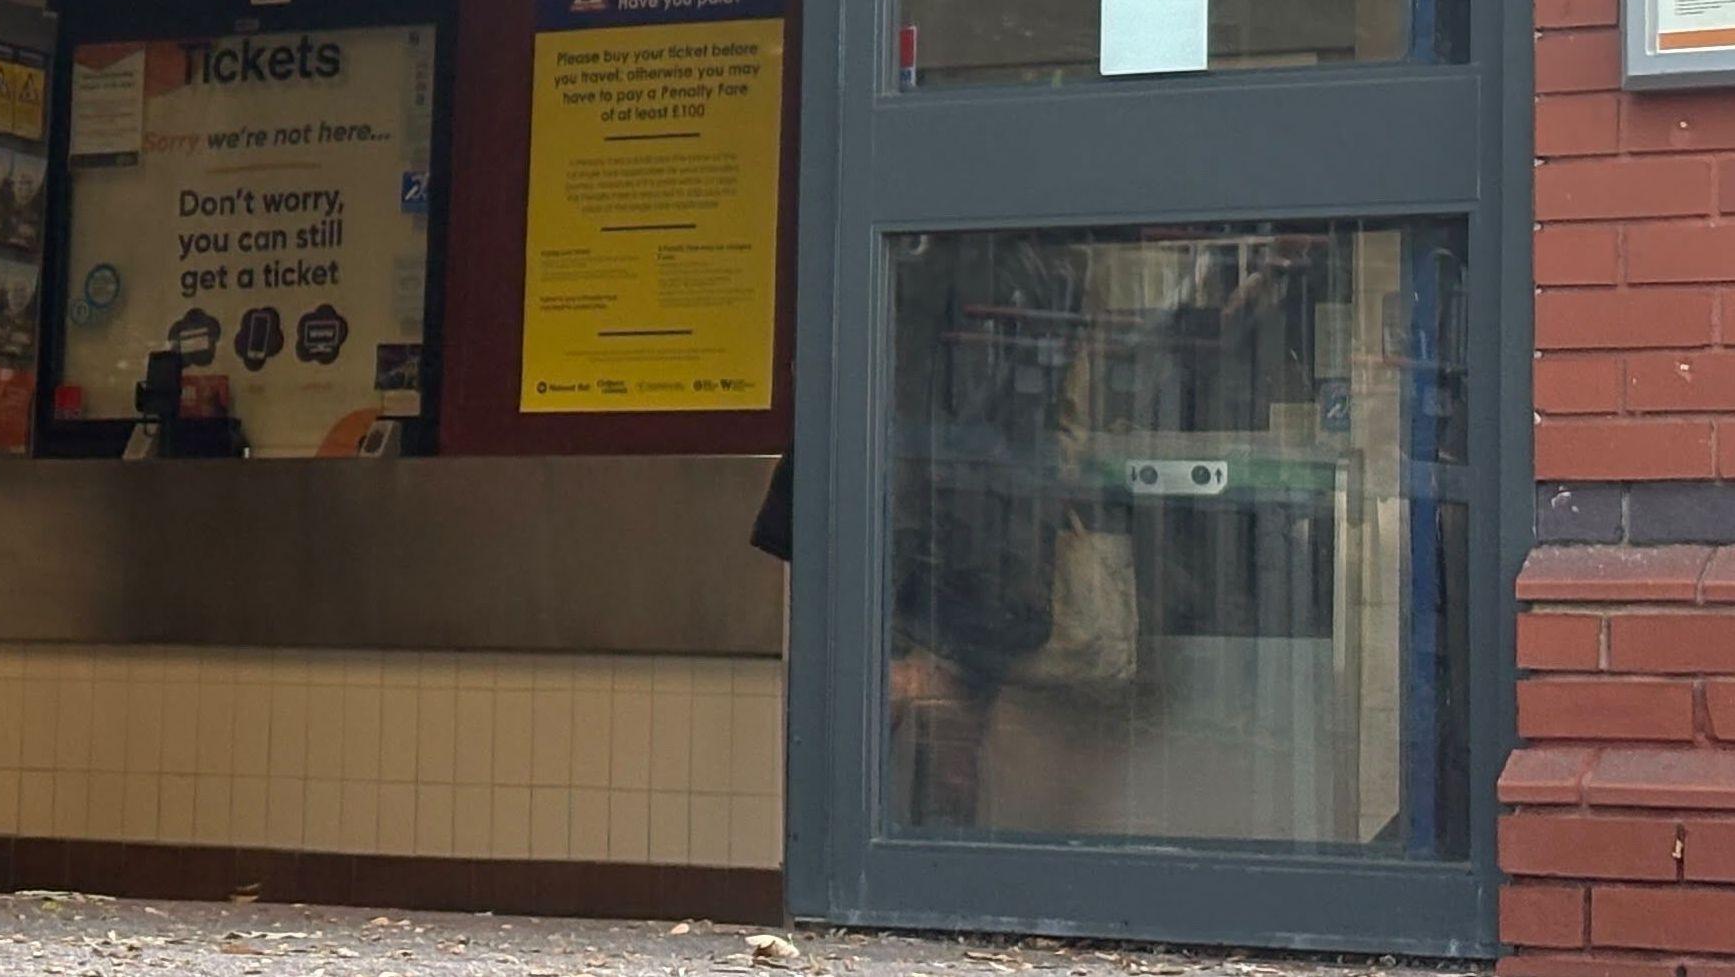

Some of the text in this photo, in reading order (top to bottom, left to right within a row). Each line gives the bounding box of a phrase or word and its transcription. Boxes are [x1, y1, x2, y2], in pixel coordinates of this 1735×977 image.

[177, 35, 341, 85] Tickets
[557, 42, 758, 66] Please buy your ticket before
[554, 73, 576, 88] you
[627, 65, 693, 81] otherwise
[697, 64, 724, 80] you
[728, 62, 760, 78] may
[563, 81, 748, 105] have to pay a Penalty Fare
[601, 103, 705, 122] of at least £100
[143, 130, 200, 156] Sorry
[273, 125, 312, 145] not
[318, 121, 391, 143] here...
[179, 188, 344, 217] Don't worry,
[179, 219, 343, 261] you can still
[181, 259, 339, 298] get a ticket
